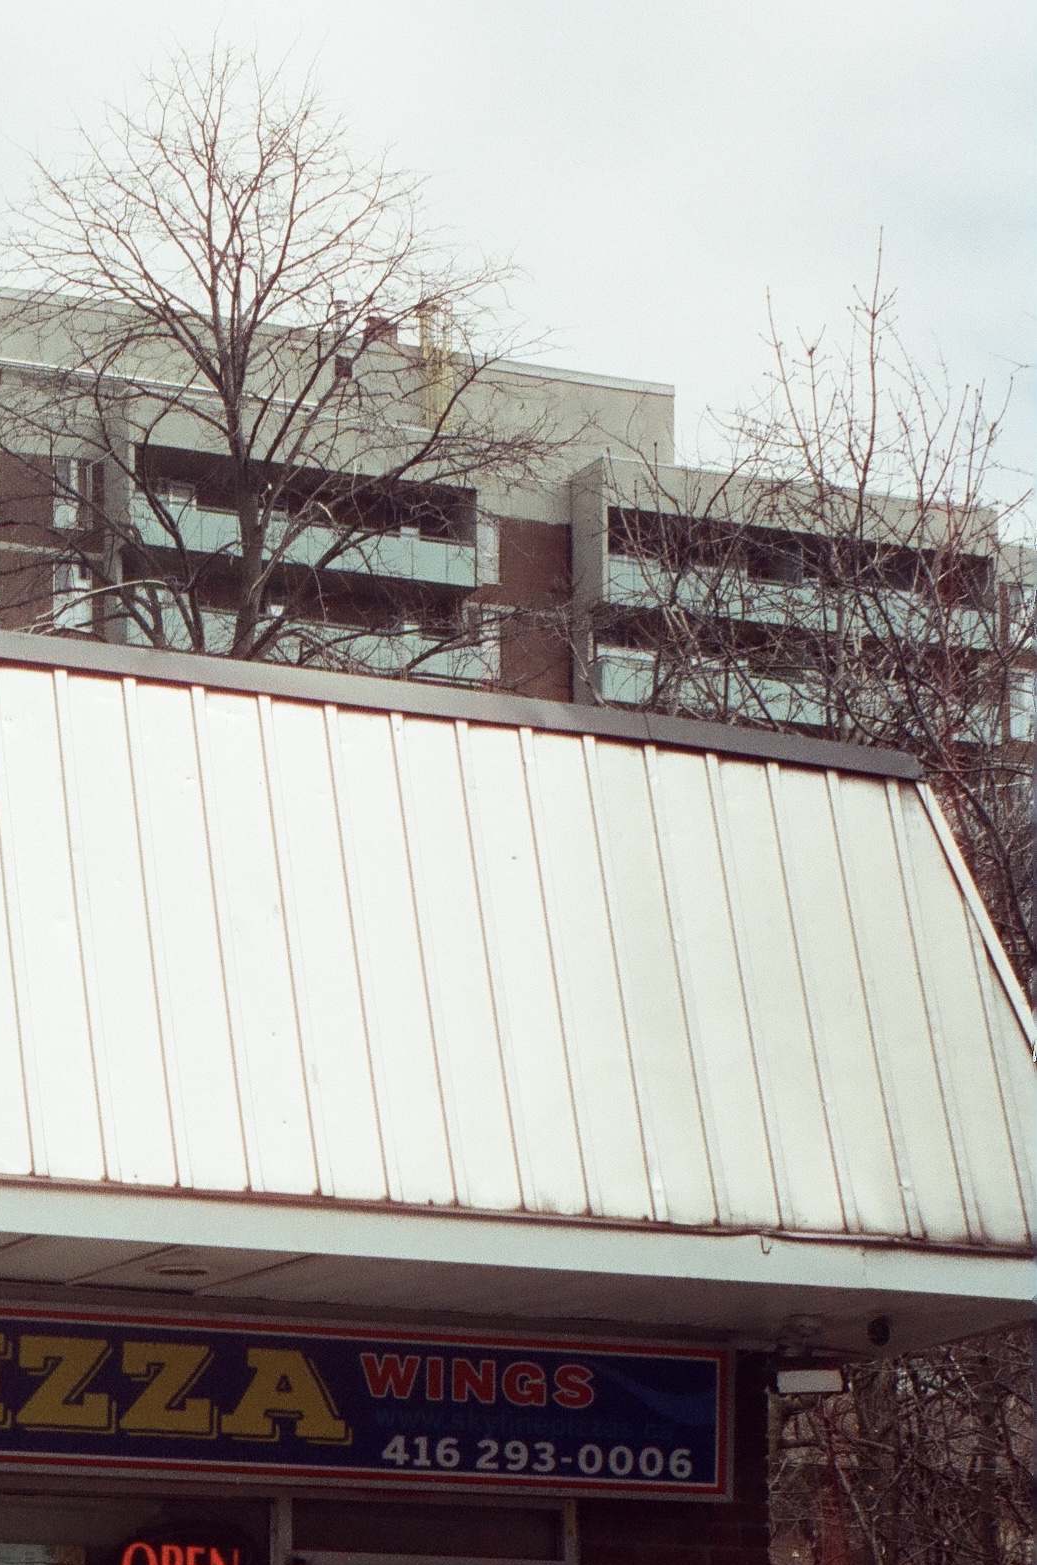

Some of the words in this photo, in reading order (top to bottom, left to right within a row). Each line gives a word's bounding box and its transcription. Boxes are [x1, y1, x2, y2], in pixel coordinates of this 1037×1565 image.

[360, 1351, 597, 1409] WINGS
[381, 1435, 461, 1468] 416
[475, 1439, 693, 1479] 293-0006
